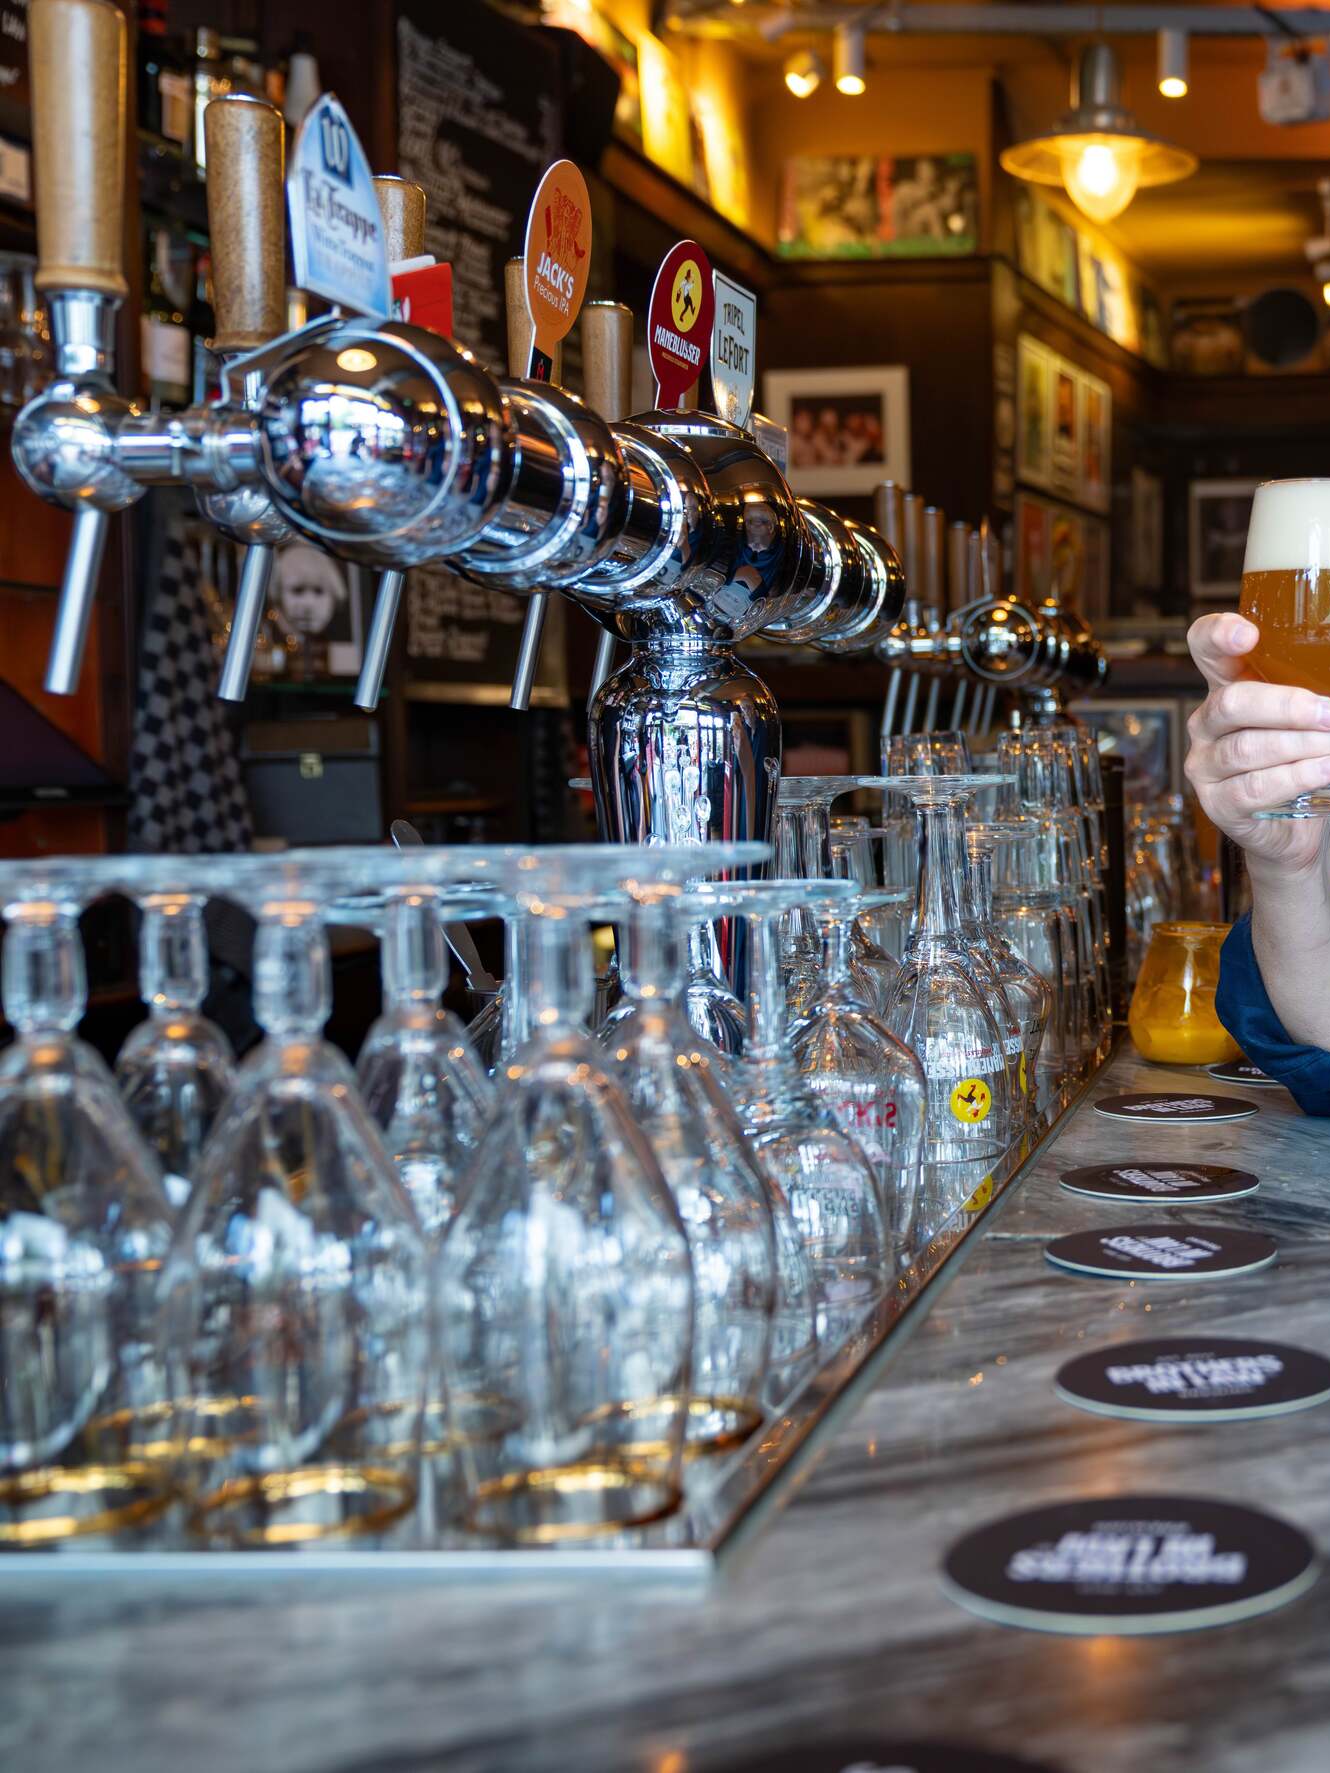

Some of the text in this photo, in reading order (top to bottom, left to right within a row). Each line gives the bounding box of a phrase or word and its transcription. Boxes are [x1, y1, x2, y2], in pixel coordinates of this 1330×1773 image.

[321, 180, 377, 244] Trappe
[533, 275, 570, 317] Precious IPA
[537, 251, 574, 299] JACK'S
[723, 302, 745, 337] TRIPEL
[654, 324, 700, 366] MANEBLUSSER
